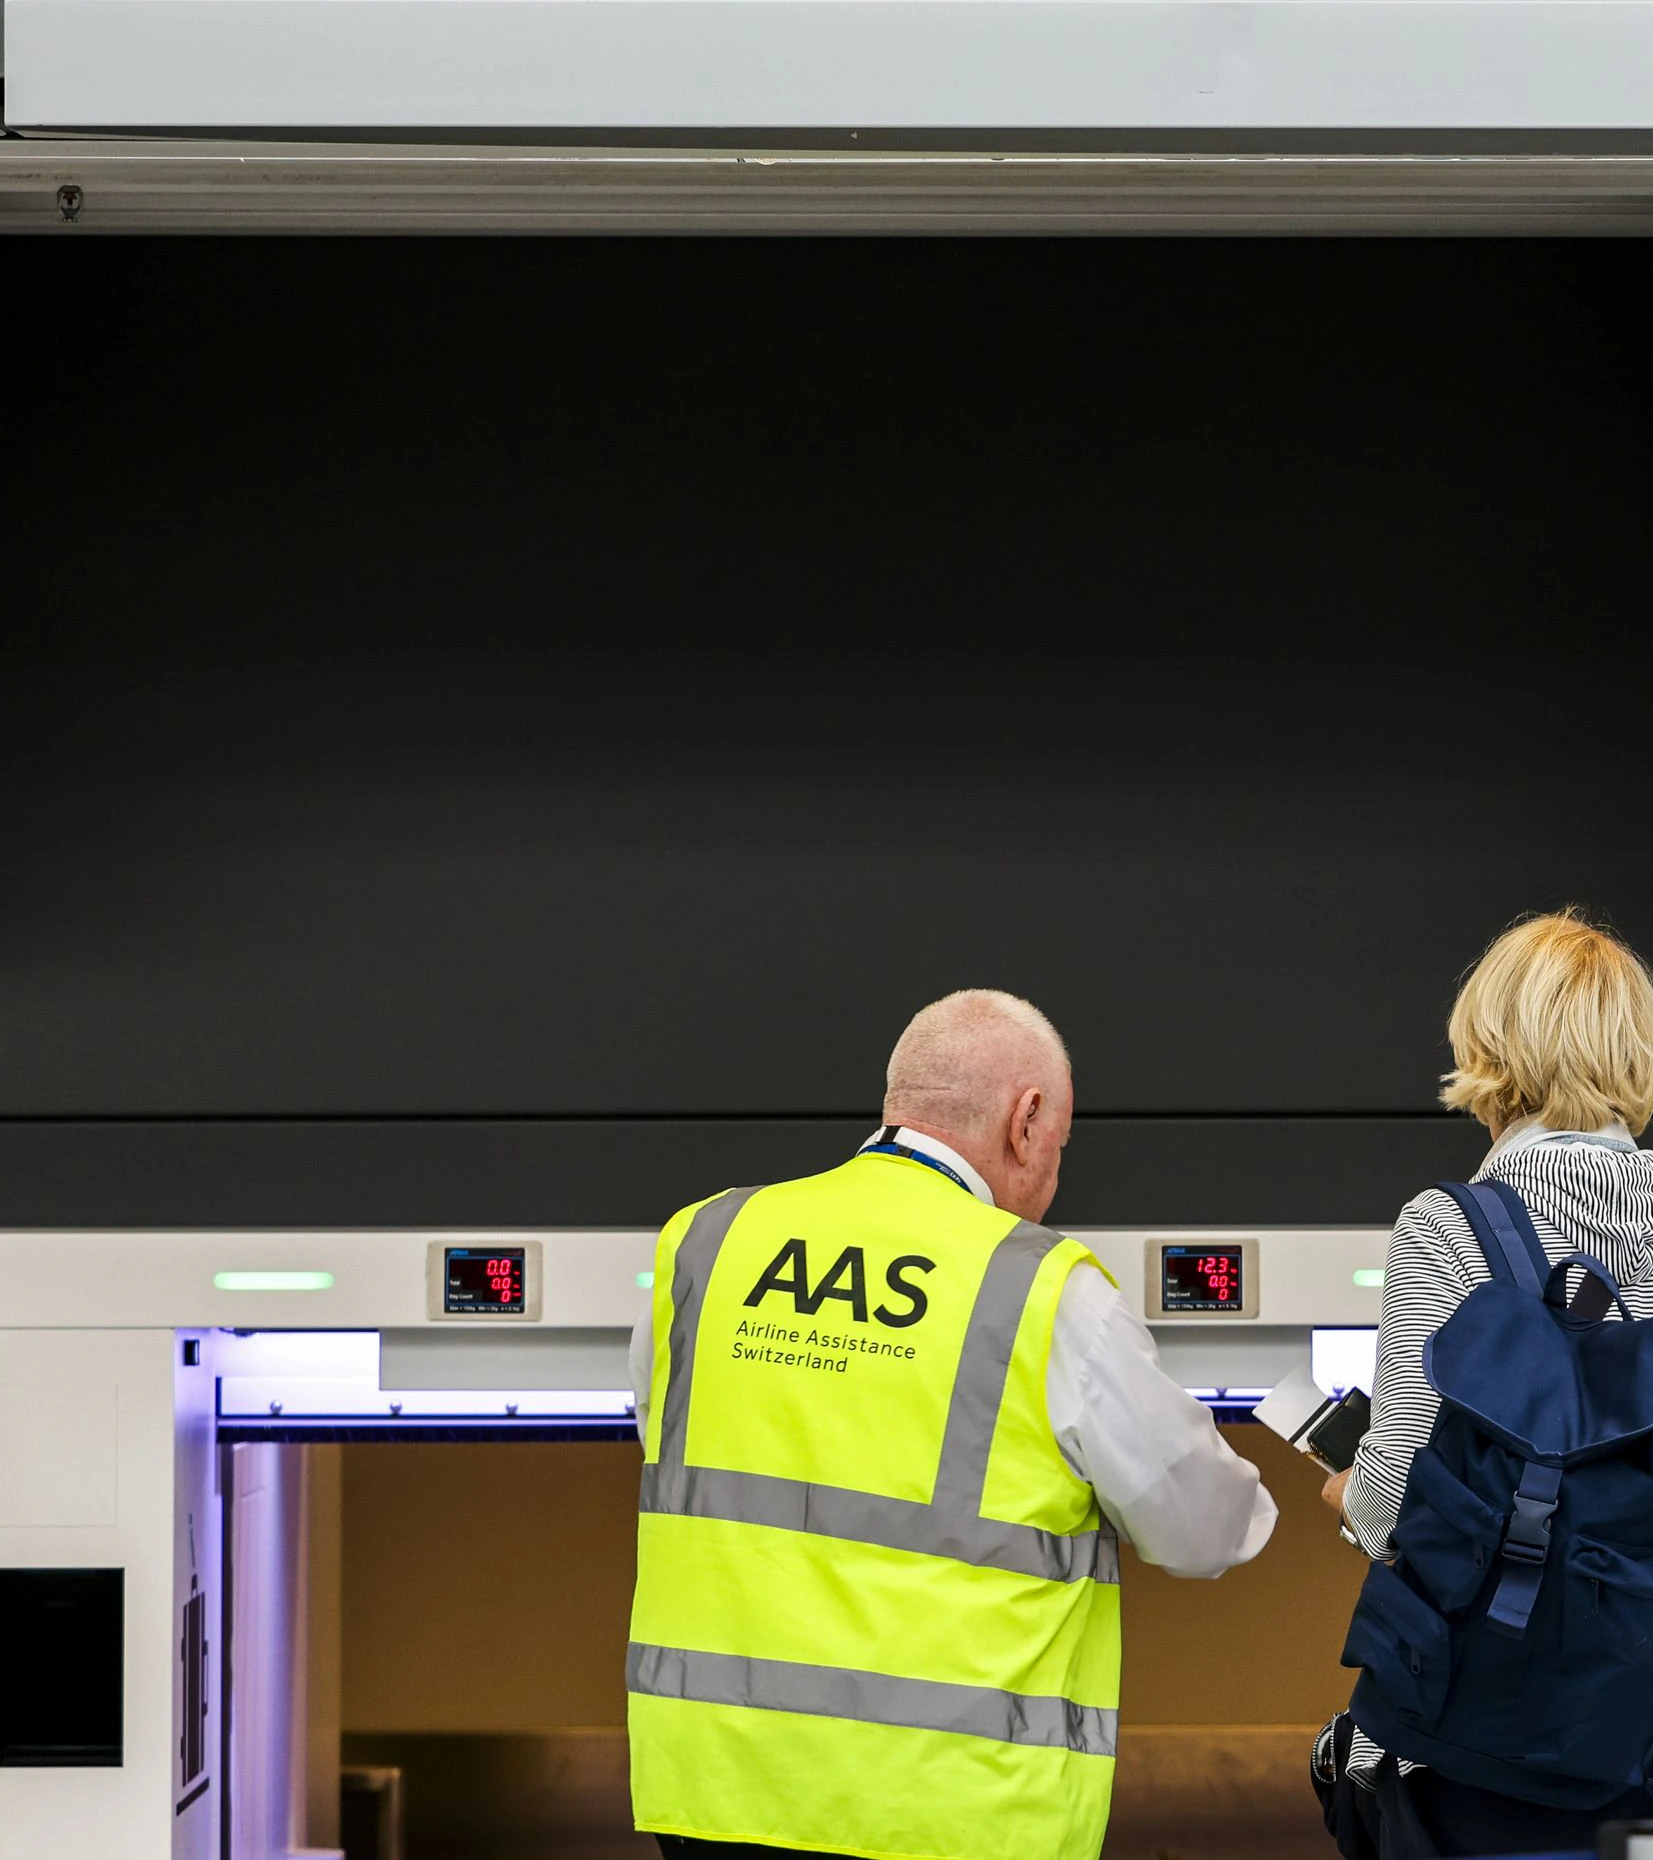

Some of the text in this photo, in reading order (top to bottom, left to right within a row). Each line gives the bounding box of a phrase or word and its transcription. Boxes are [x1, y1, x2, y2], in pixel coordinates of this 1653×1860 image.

[1197, 1257, 1228, 1273] 12.3
[742, 1238, 937, 1329] AAS
[731, 1342, 849, 1373] Switzerland
[735, 1320, 917, 1360] Airline Assistance
